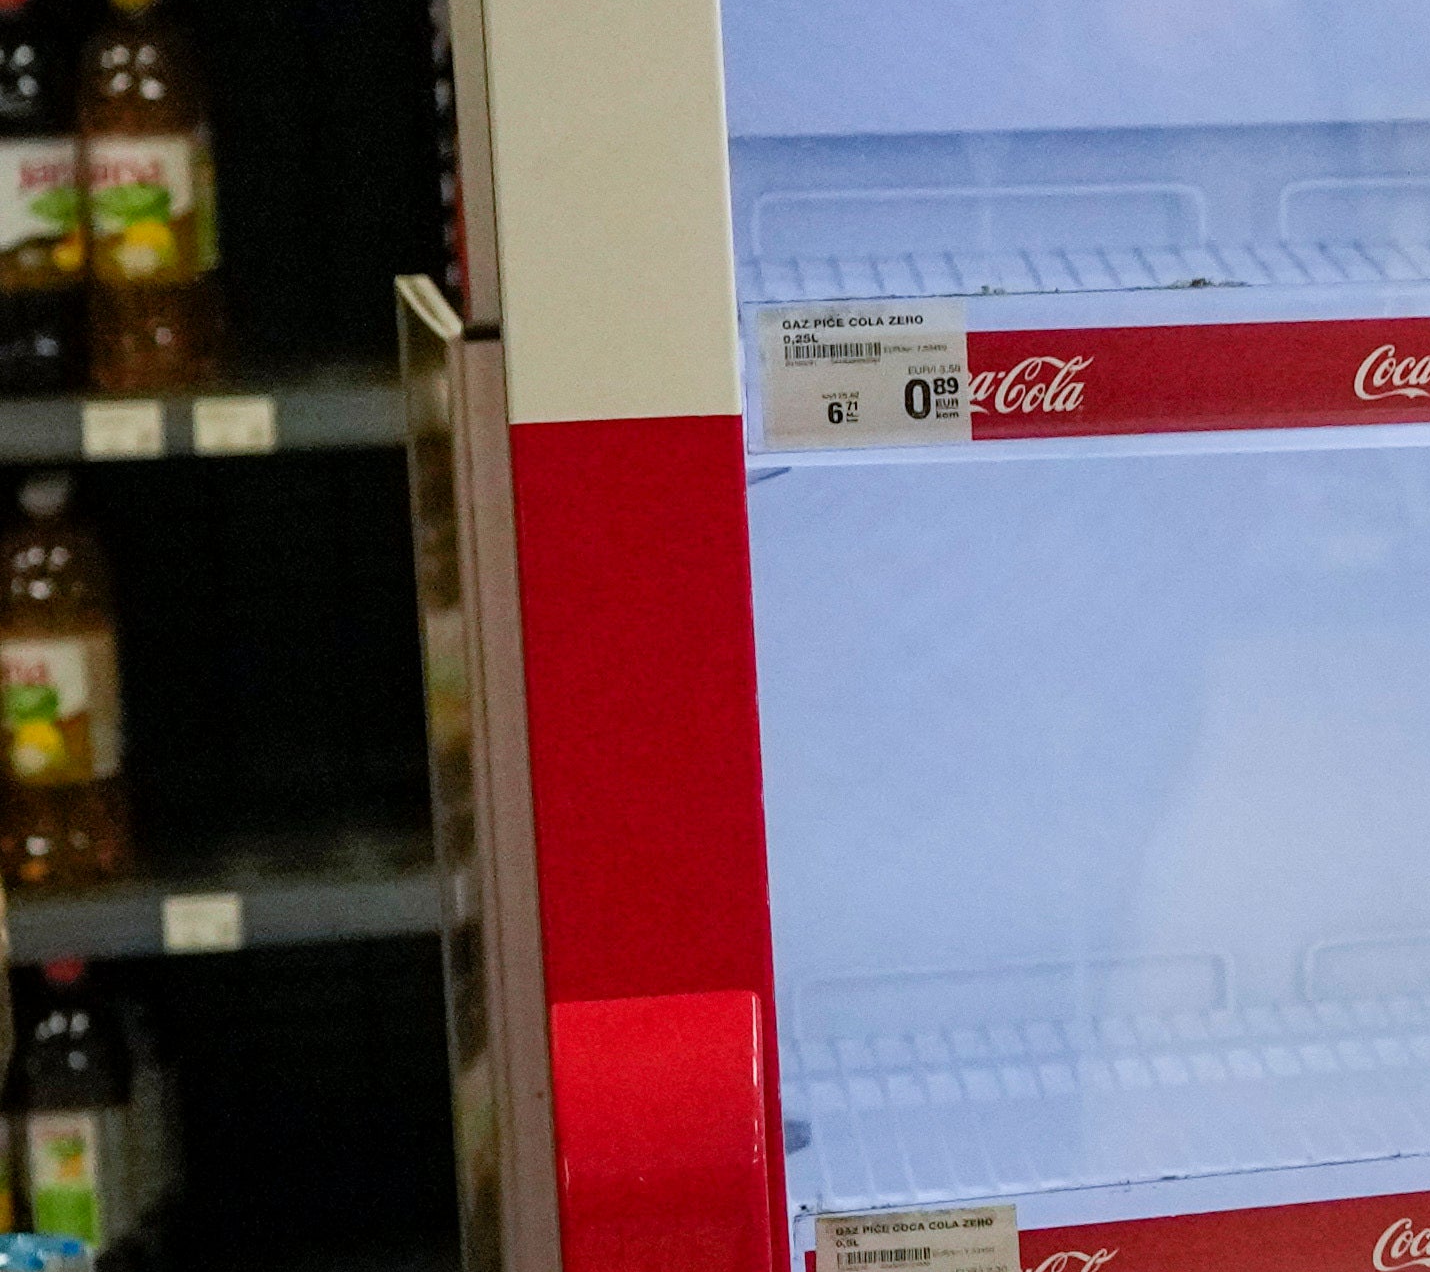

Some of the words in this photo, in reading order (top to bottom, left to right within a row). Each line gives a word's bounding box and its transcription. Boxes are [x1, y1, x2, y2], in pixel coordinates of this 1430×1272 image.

[849, 316, 885, 327] COLA
[904, 378, 932, 420] 0
[933, 376, 960, 395] 89
[936, 398, 959, 409] EUR
[828, 401, 843, 424] 6
[846, 401, 858, 411] 71
[936, 410, 960, 420] kom
[893, 1222, 925, 1233] COCA
[928, 1220, 959, 1231] COLA
[963, 1217, 994, 1228] ZERO
